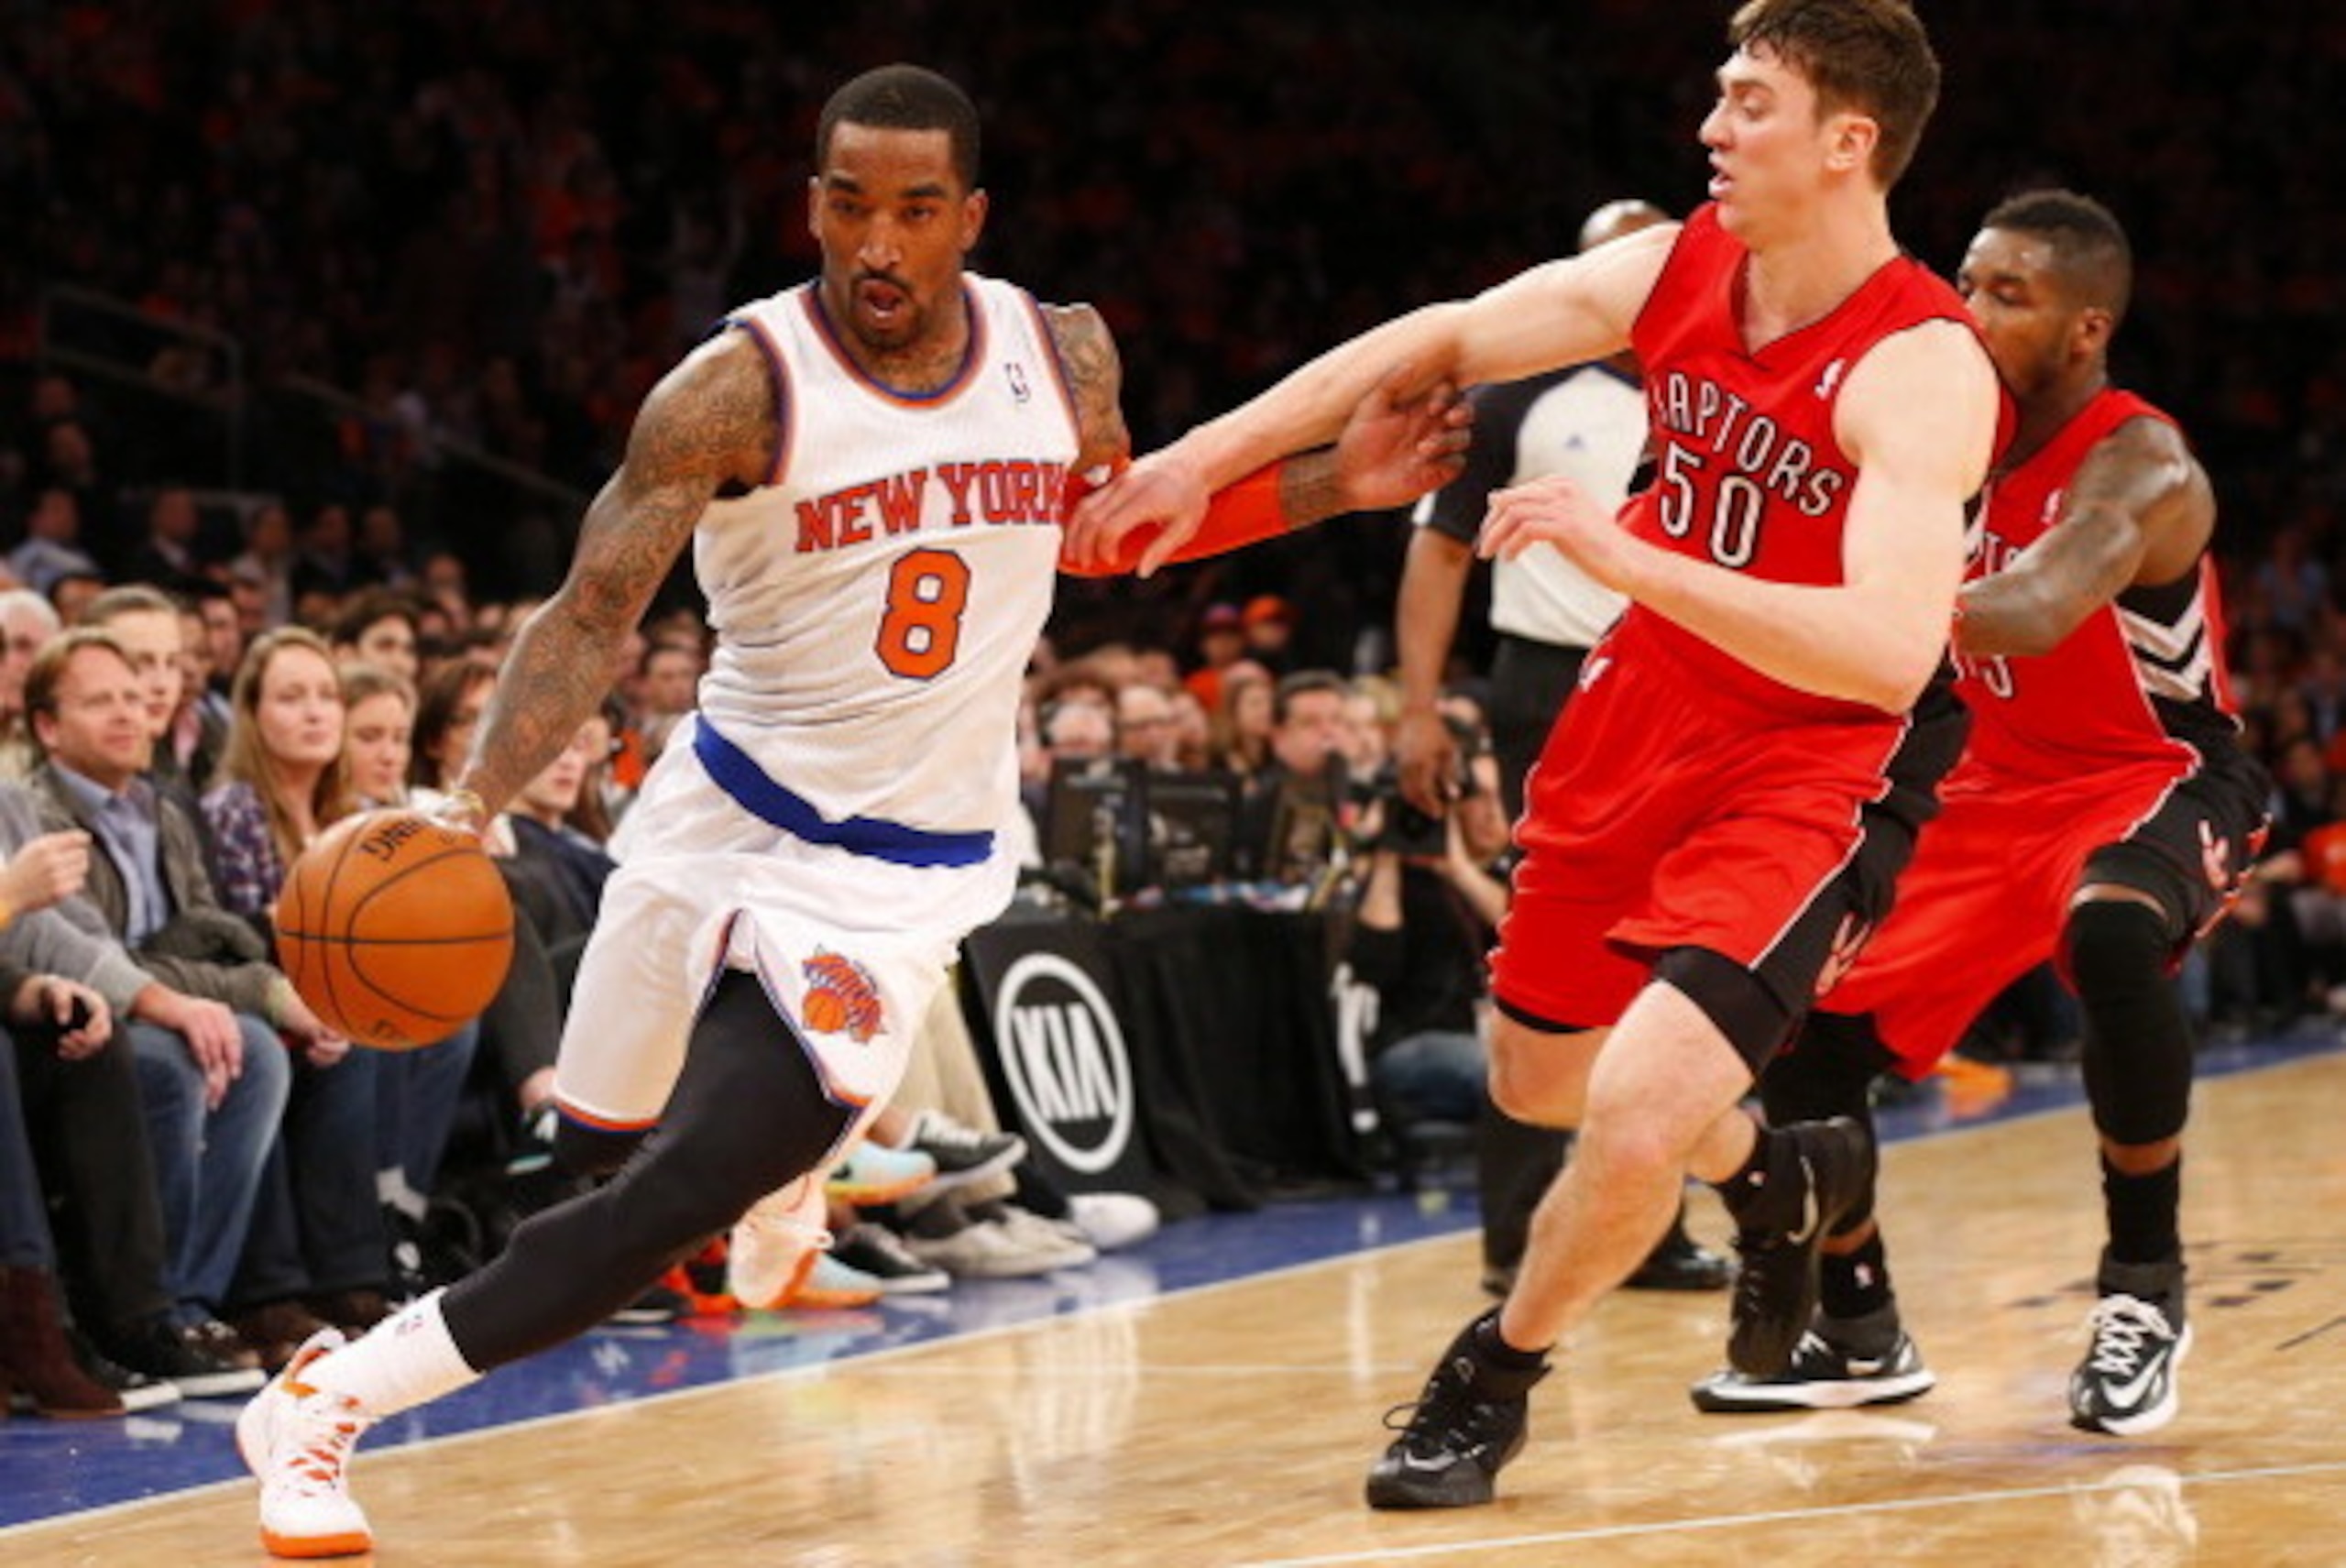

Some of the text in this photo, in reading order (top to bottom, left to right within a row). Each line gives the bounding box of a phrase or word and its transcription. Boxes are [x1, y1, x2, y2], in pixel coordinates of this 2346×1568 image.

[794, 466, 928, 553] NEW
[1658, 439, 1764, 569] 50
[873, 546, 971, 681] 8
[1010, 1001, 1119, 1121] KIA
